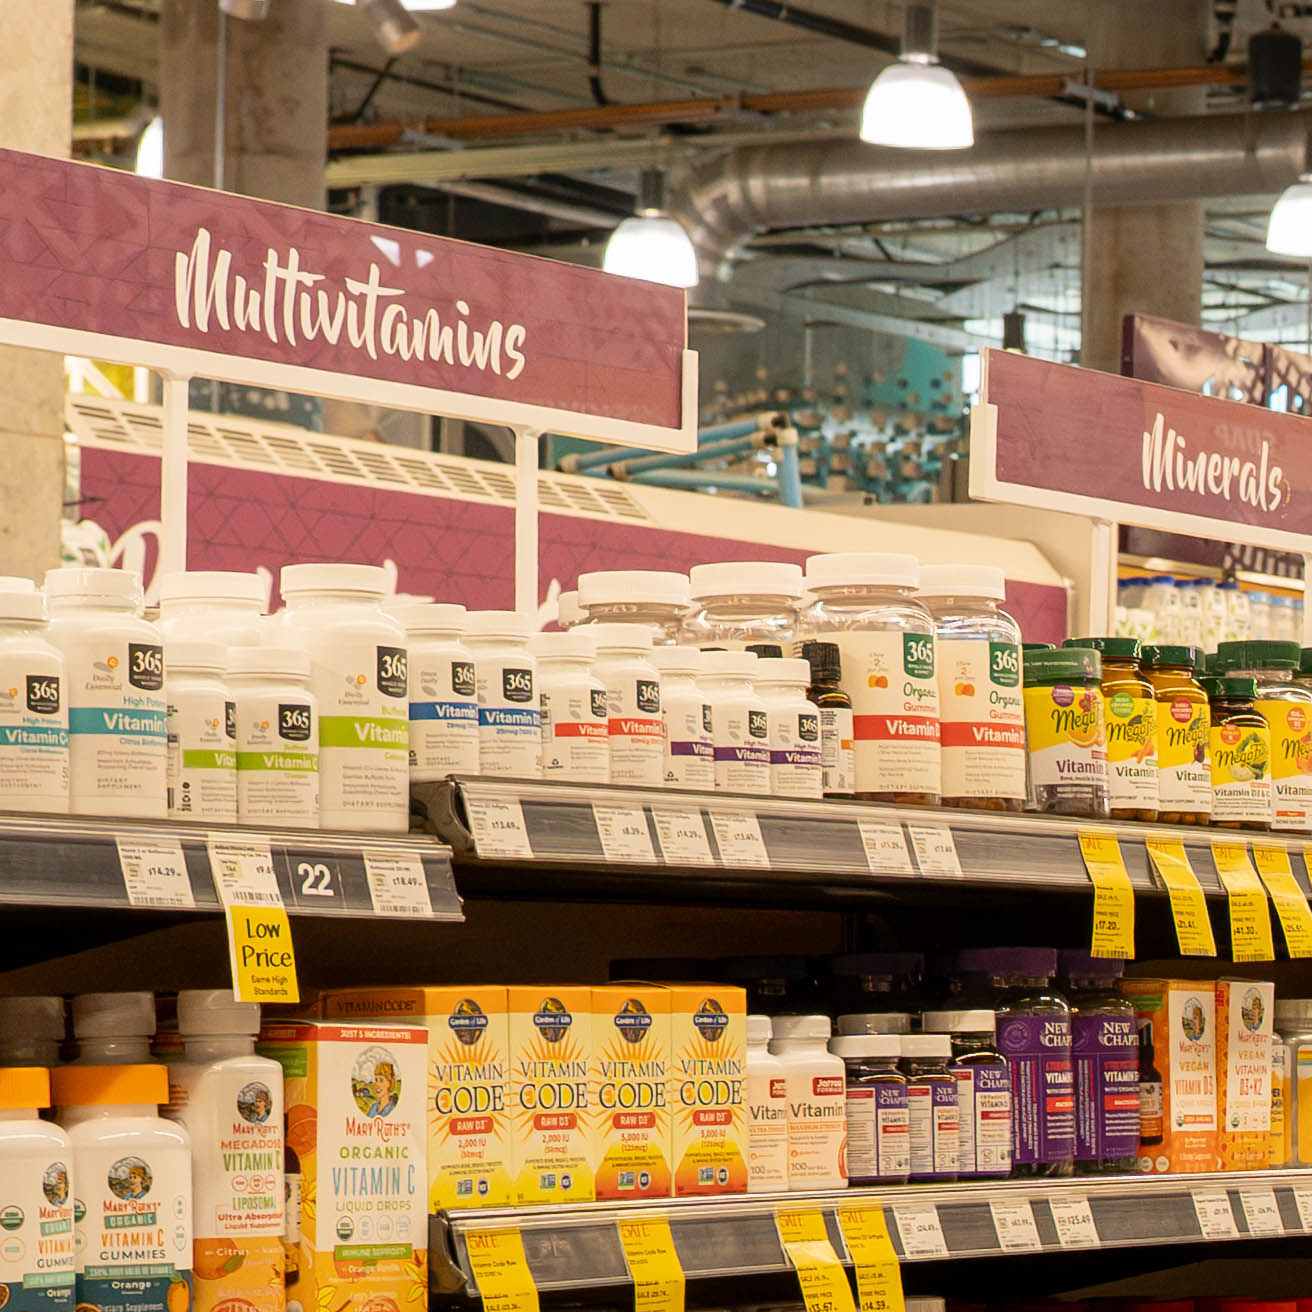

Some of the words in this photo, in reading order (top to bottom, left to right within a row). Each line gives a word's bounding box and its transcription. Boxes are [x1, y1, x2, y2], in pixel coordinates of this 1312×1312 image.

[174, 227, 527, 381] Multivitamins
[1142, 412, 1283, 512] Minerals
[906, 641, 933, 664] 365
[993, 651, 1018, 672] 365
[132, 650, 163, 675] 365
[381, 654, 408, 680] 365
[30, 680, 58, 701] 365
[506, 673, 531, 691] 365
[103, 712, 163, 733] Vitamin
[281, 710, 310, 729] 365
[485, 710, 533, 725] Vitamin
[6, 729, 59, 745] Vitamin
[886, 720, 933, 737] Vitamin
[972, 727, 1020, 744] Vitamin
[263, 754, 312, 770] Vitamin
[1056, 760, 1105, 775] Vitamin
[298, 862, 334, 896] 22
[246, 918, 281, 939] Low
[242, 945, 293, 969] Price
[250, 975, 270, 984] Same
[271, 975, 288, 986] High
[253, 986, 289, 997] Standards
[1103, 1021, 1132, 1034] NEW
[435, 1062, 504, 1083] VITAMIN
[520, 1061, 588, 1079] VITAMIN
[600, 1060, 666, 1078] VITAMIN
[681, 1059, 742, 1076] VITAMIN
[435, 1085, 506, 1115] CODE
[519, 1082, 589, 1110] CODE
[599, 1081, 667, 1109] CODE
[680, 1080, 743, 1106] CODE
[790, 1102, 844, 1119] Vitamin
[456, 1121, 474, 1131] RAW
[541, 1117, 558, 1127] RAW
[339, 1146, 409, 1160] ORGANIC
[223, 1153, 274, 1172] VITAMIN
[332, 1166, 401, 1197] VITAMIN
[407, 1164, 416, 1195] C
[335, 1200, 374, 1213] LIQUID
[376, 1200, 412, 1211] DROPS
[100, 1231, 152, 1248] VITAMIN
[157, 1229, 165, 1247] C
[99, 1249, 167, 1262] GUMMIES
[111, 1281, 152, 1290] Orange
